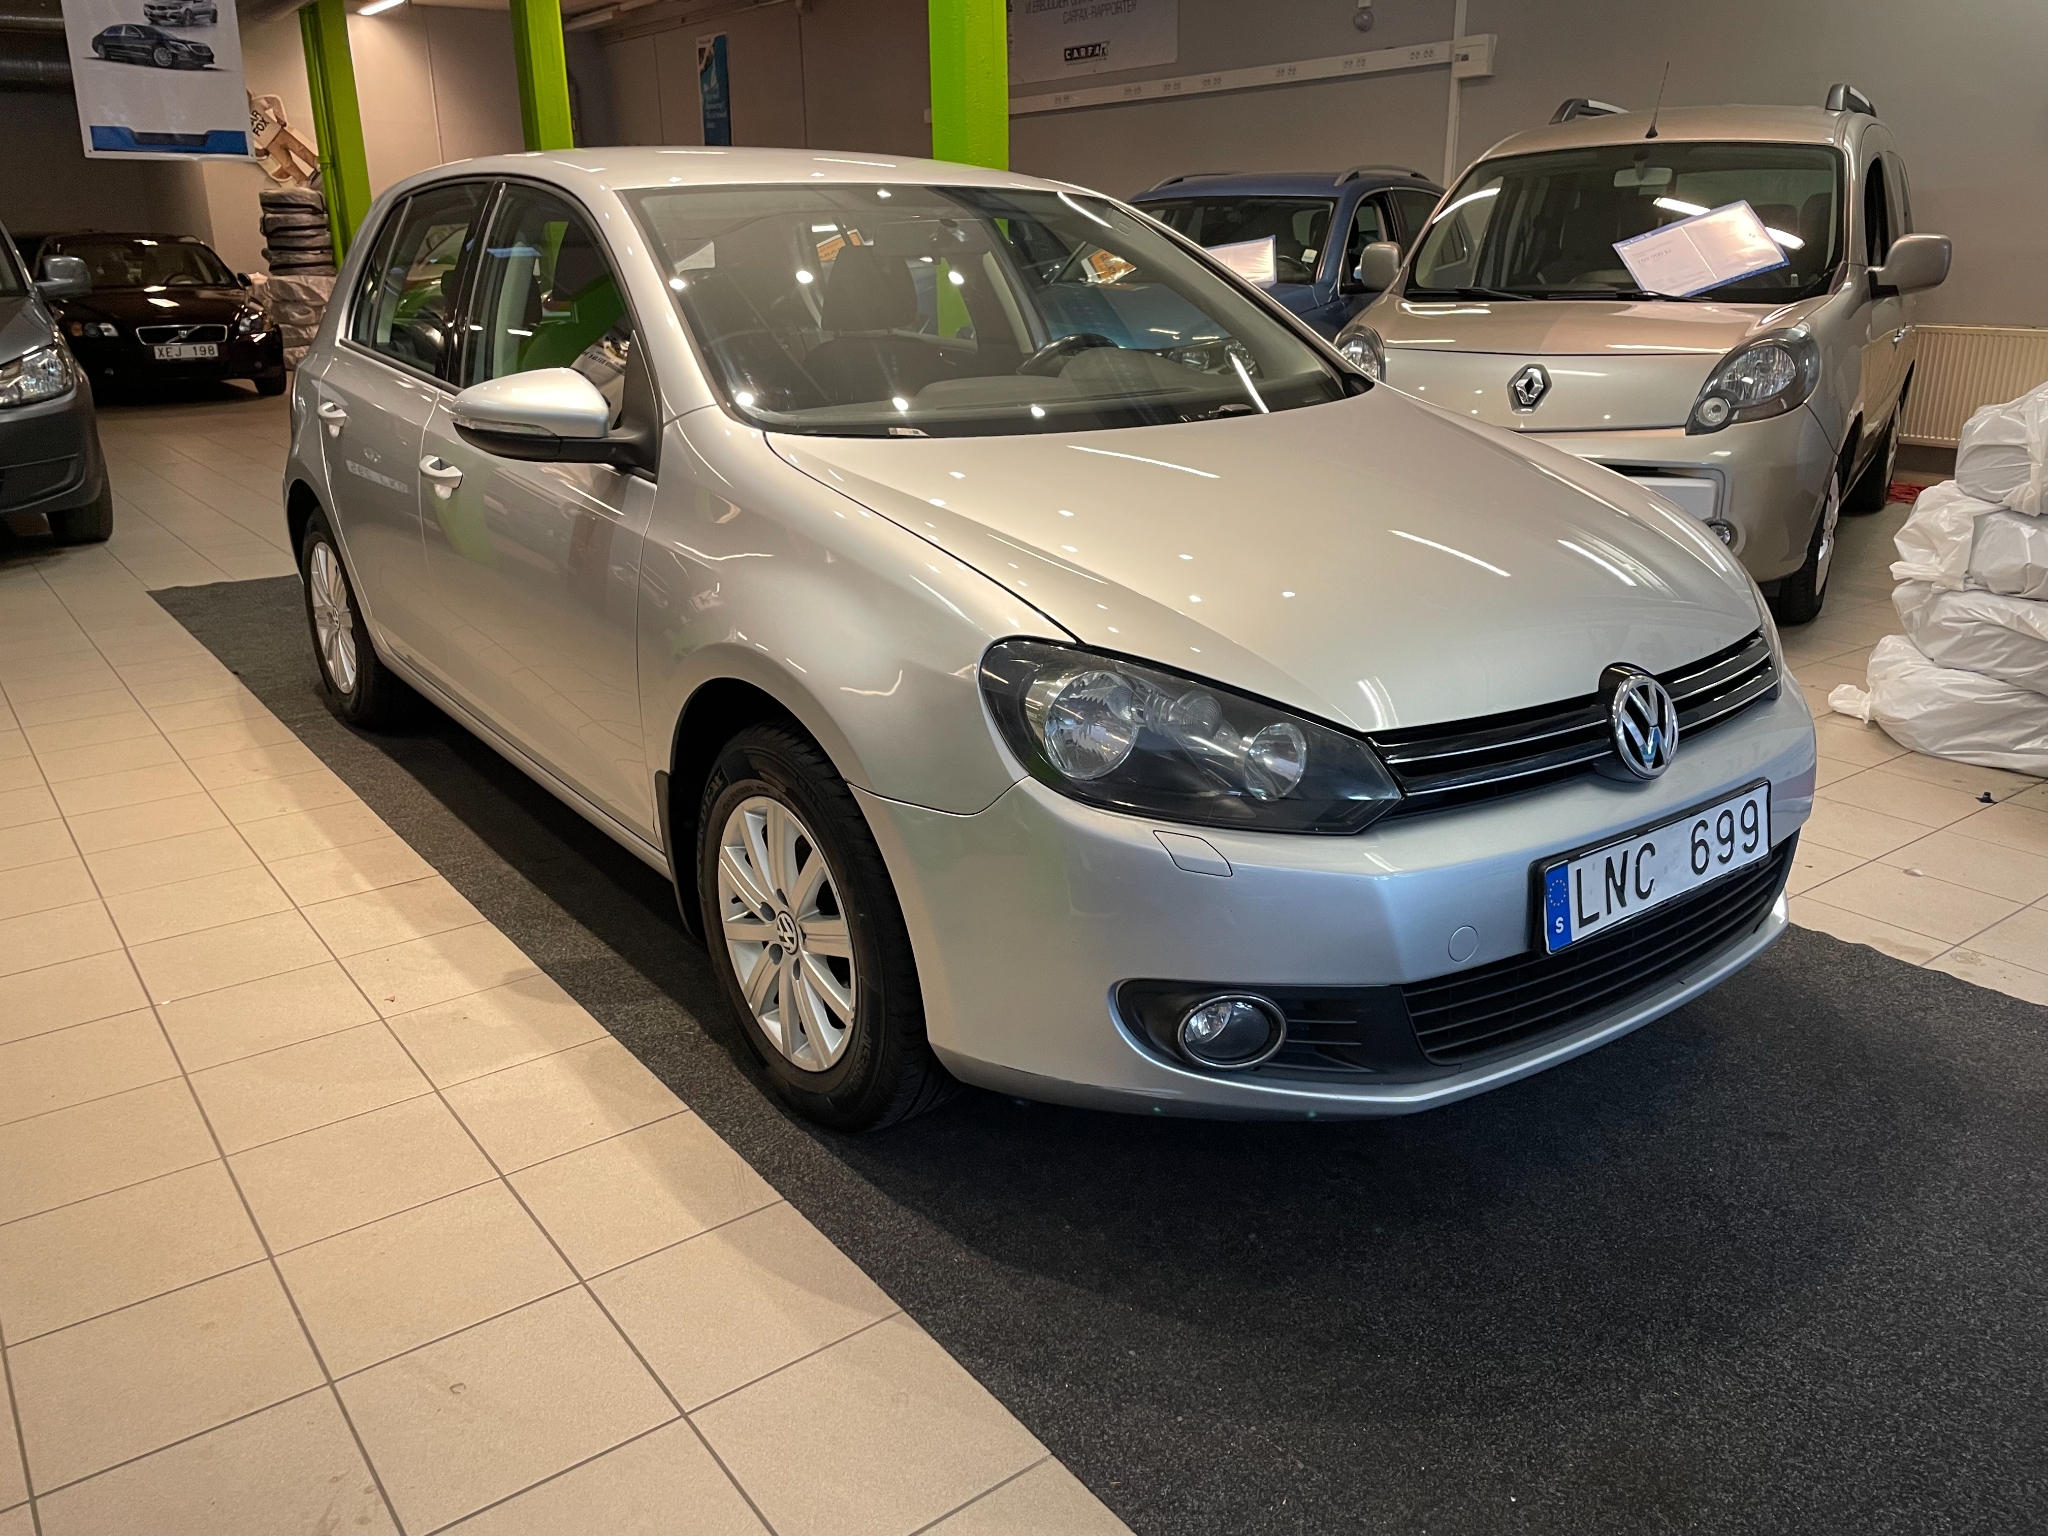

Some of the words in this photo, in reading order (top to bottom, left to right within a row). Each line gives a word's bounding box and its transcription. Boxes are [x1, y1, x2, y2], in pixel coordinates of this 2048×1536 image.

[252, 117, 270, 137] FOX
[156, 346, 182, 358] XEJ
[192, 345, 215, 356] 198
[1576, 842, 1656, 929] LNC
[1690, 799, 1759, 876] 699
[1555, 916, 1565, 934] S
